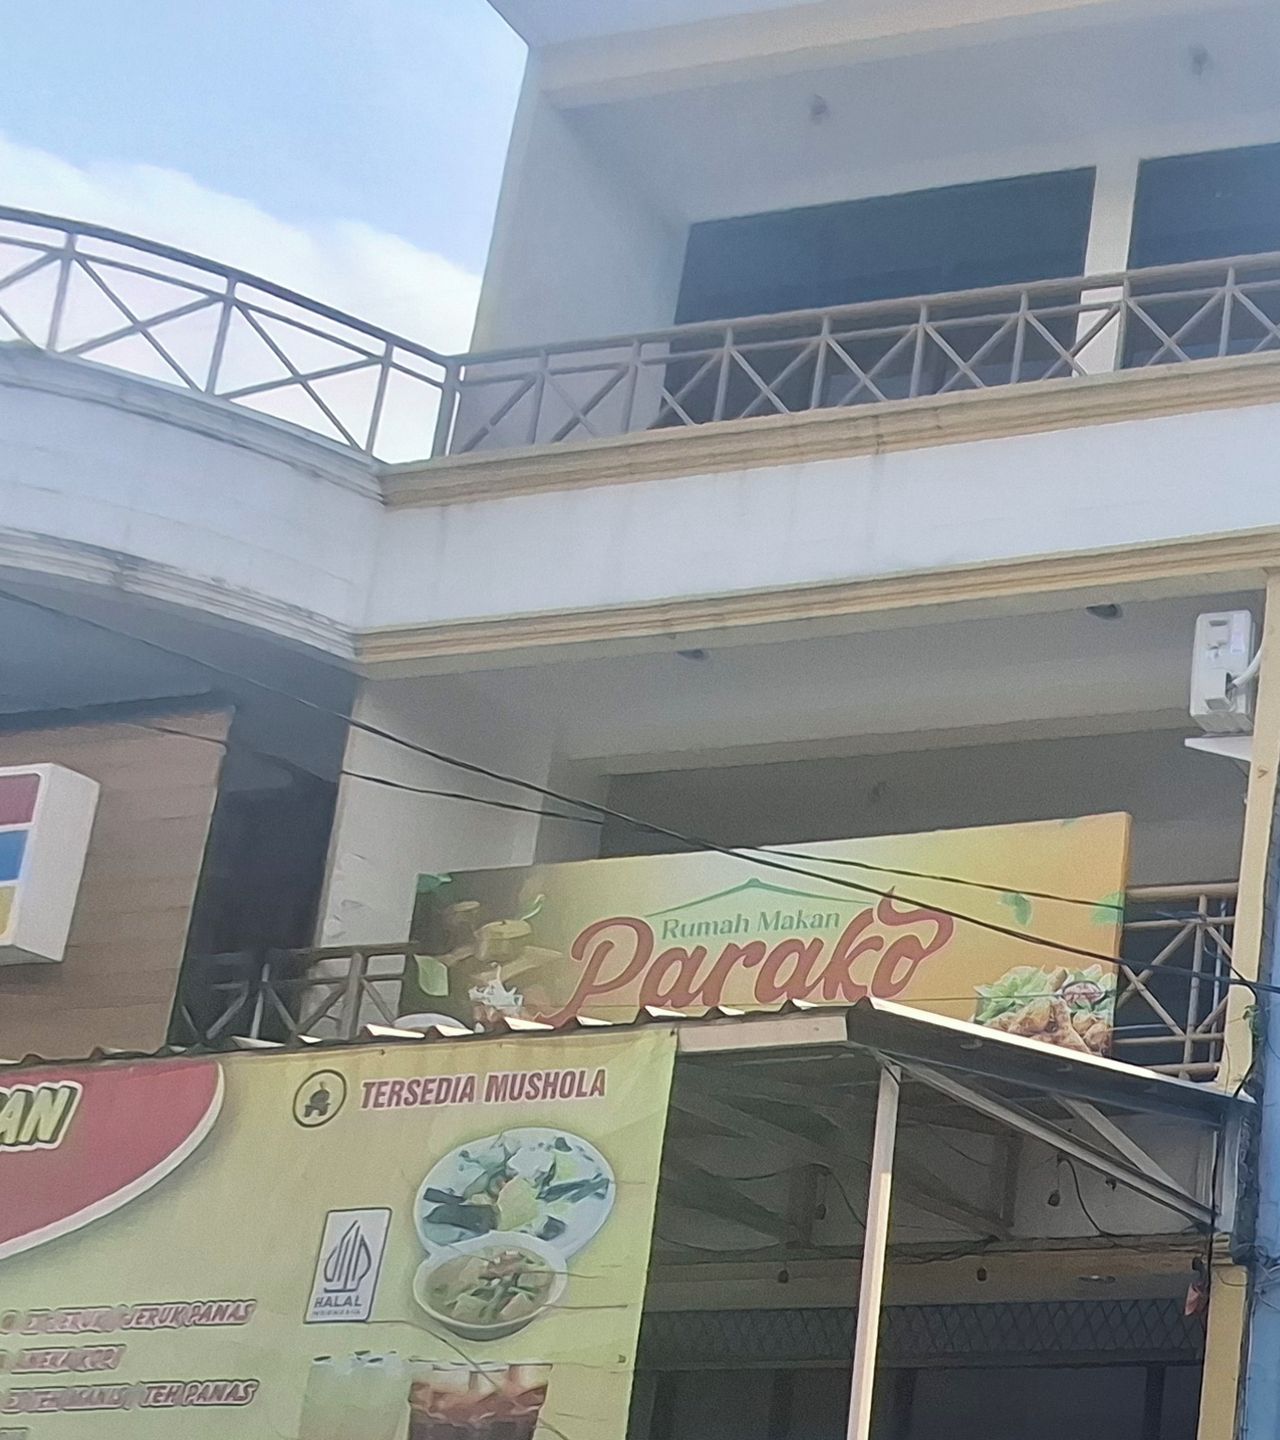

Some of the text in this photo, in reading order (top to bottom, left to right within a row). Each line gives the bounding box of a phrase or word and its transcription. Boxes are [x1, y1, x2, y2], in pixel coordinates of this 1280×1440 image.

[662, 910, 841, 940] Rumah Makan
[534, 884, 956, 1029] Parako
[361, 1068, 607, 1109] TERSEDIA MUSHOLA
[187, 1300, 257, 1326] PANAS
[313, 1295, 363, 1308] HALAL
[183, 1380, 259, 1406] PANAS
